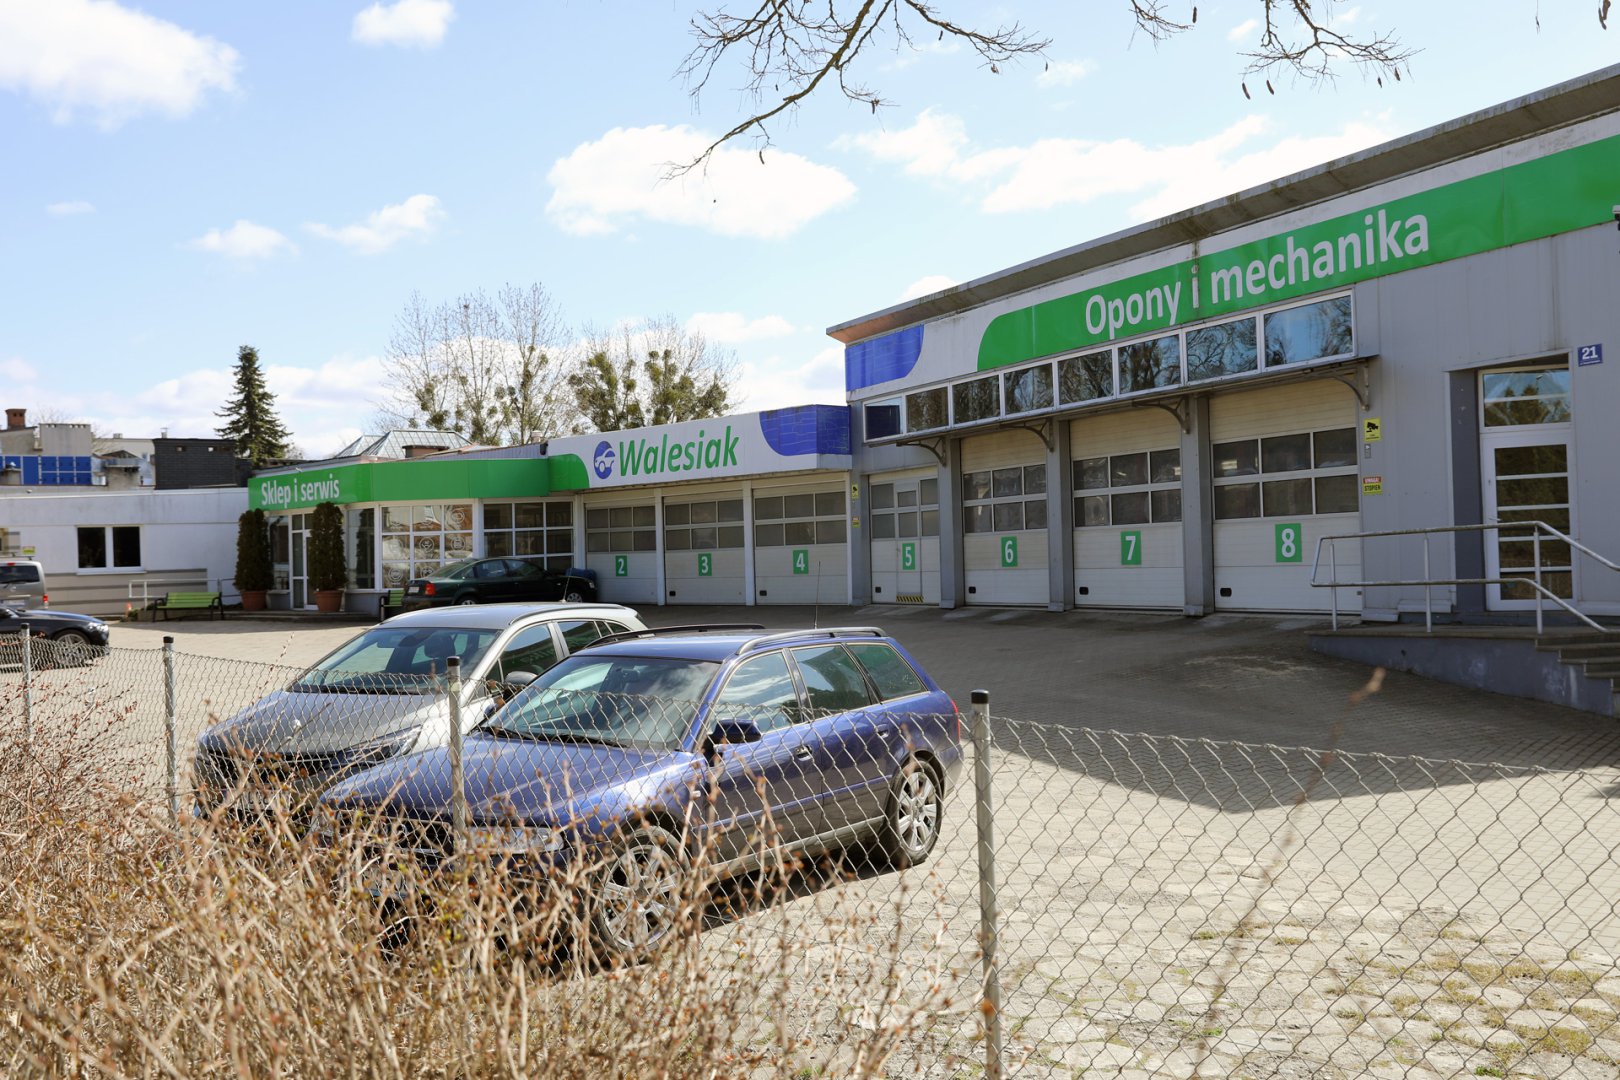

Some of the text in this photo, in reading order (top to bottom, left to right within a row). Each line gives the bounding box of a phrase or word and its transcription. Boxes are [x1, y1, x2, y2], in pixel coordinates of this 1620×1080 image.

[1085, 209, 1430, 340] Opony i mechanika
[1582, 346, 1598, 360] 21
[619, 426, 740, 477] Walesiak
[261, 473, 339, 509] Sklep i serwis
[1004, 540, 1014, 564] 6
[1125, 535, 1136, 562] 7
[1280, 529, 1296, 558] 8
[617, 558, 625, 575] 2
[701, 556, 709, 574] 3
[796, 553, 806, 572] 4
[905, 546, 913, 566] 5
